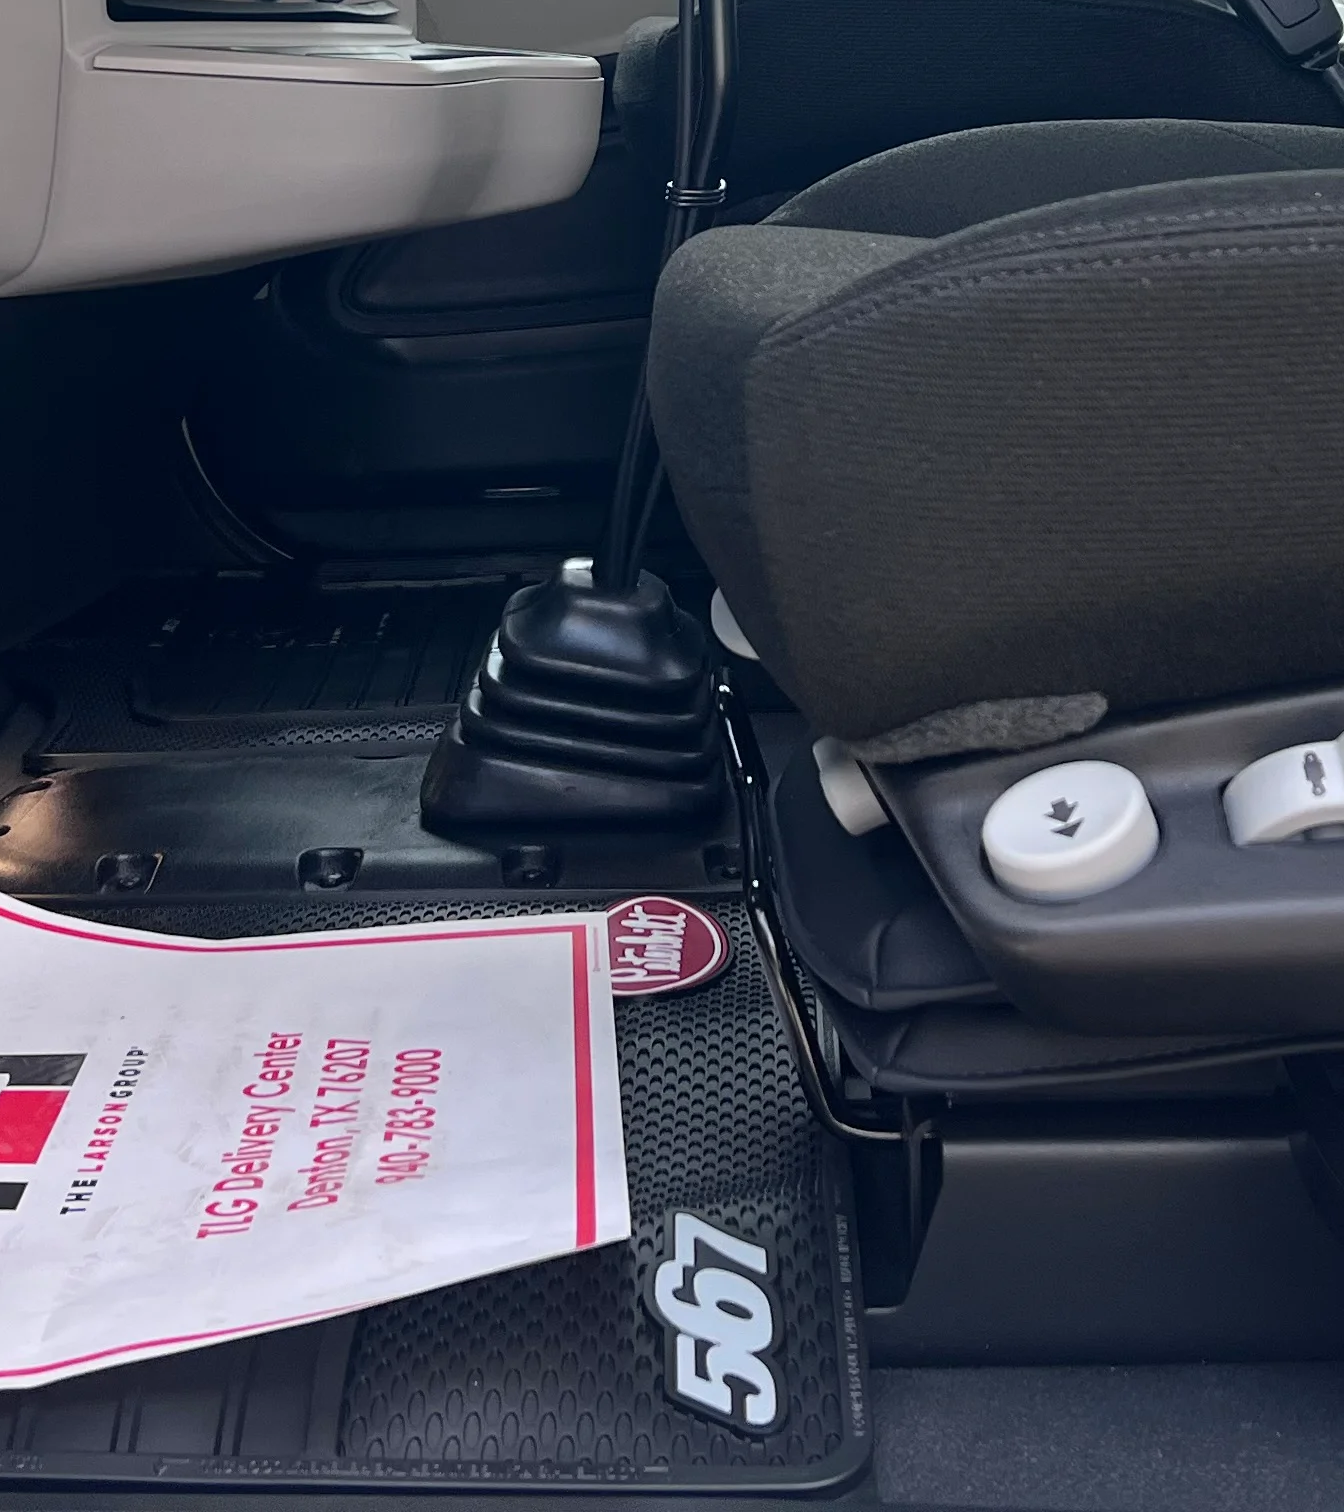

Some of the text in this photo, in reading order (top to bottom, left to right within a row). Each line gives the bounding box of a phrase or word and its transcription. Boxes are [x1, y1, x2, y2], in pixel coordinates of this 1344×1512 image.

[611, 904, 687, 983] Peterbilt
[77, 1102, 129, 1173] LARSON
[196, 1031, 303, 1239] TLG Delivery Center
[287, 1039, 370, 1212] Denton, TX 76207
[375, 1049, 442, 1184] 940-783-9000
[60, 1179, 99, 1215] THE
[658, 1212, 778, 1427] 567
